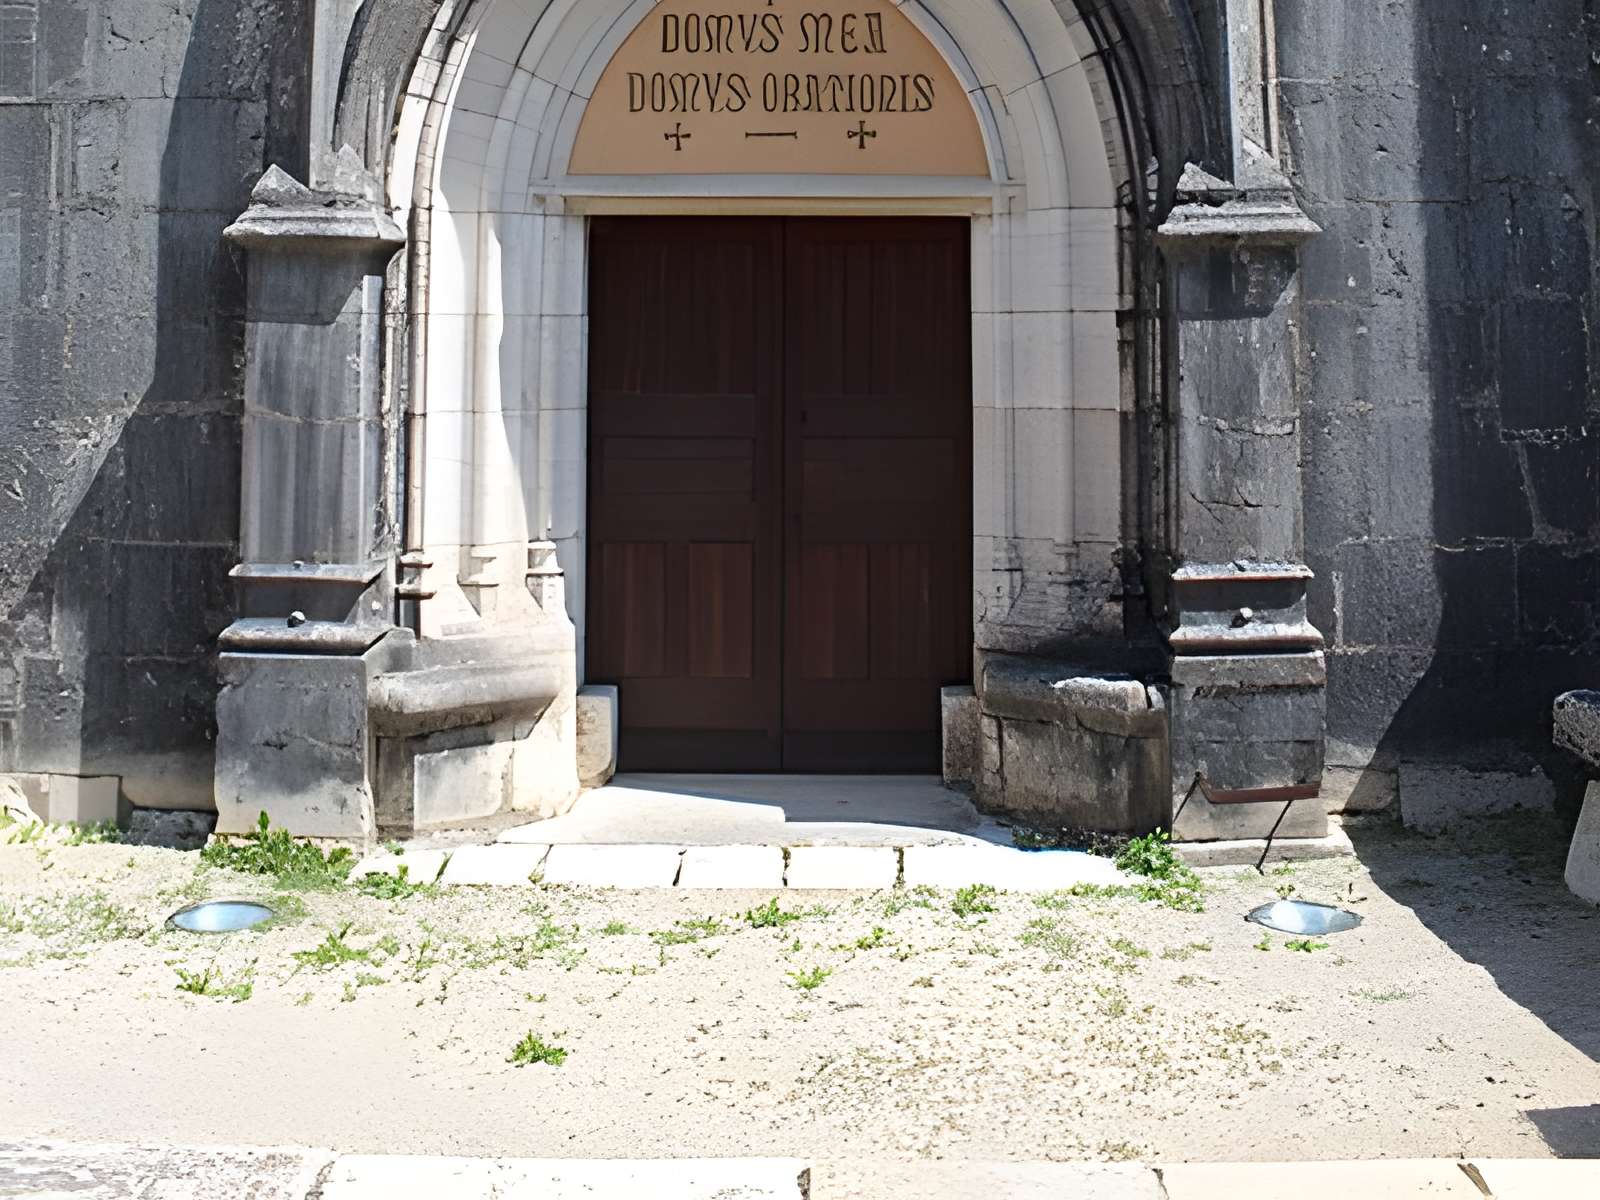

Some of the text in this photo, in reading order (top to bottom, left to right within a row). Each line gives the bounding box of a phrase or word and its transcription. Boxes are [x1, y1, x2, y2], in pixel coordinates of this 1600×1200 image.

[661, 11, 887, 54] DOMVS MEA
[627, 71, 935, 113] DOMVS ORATIONIS
